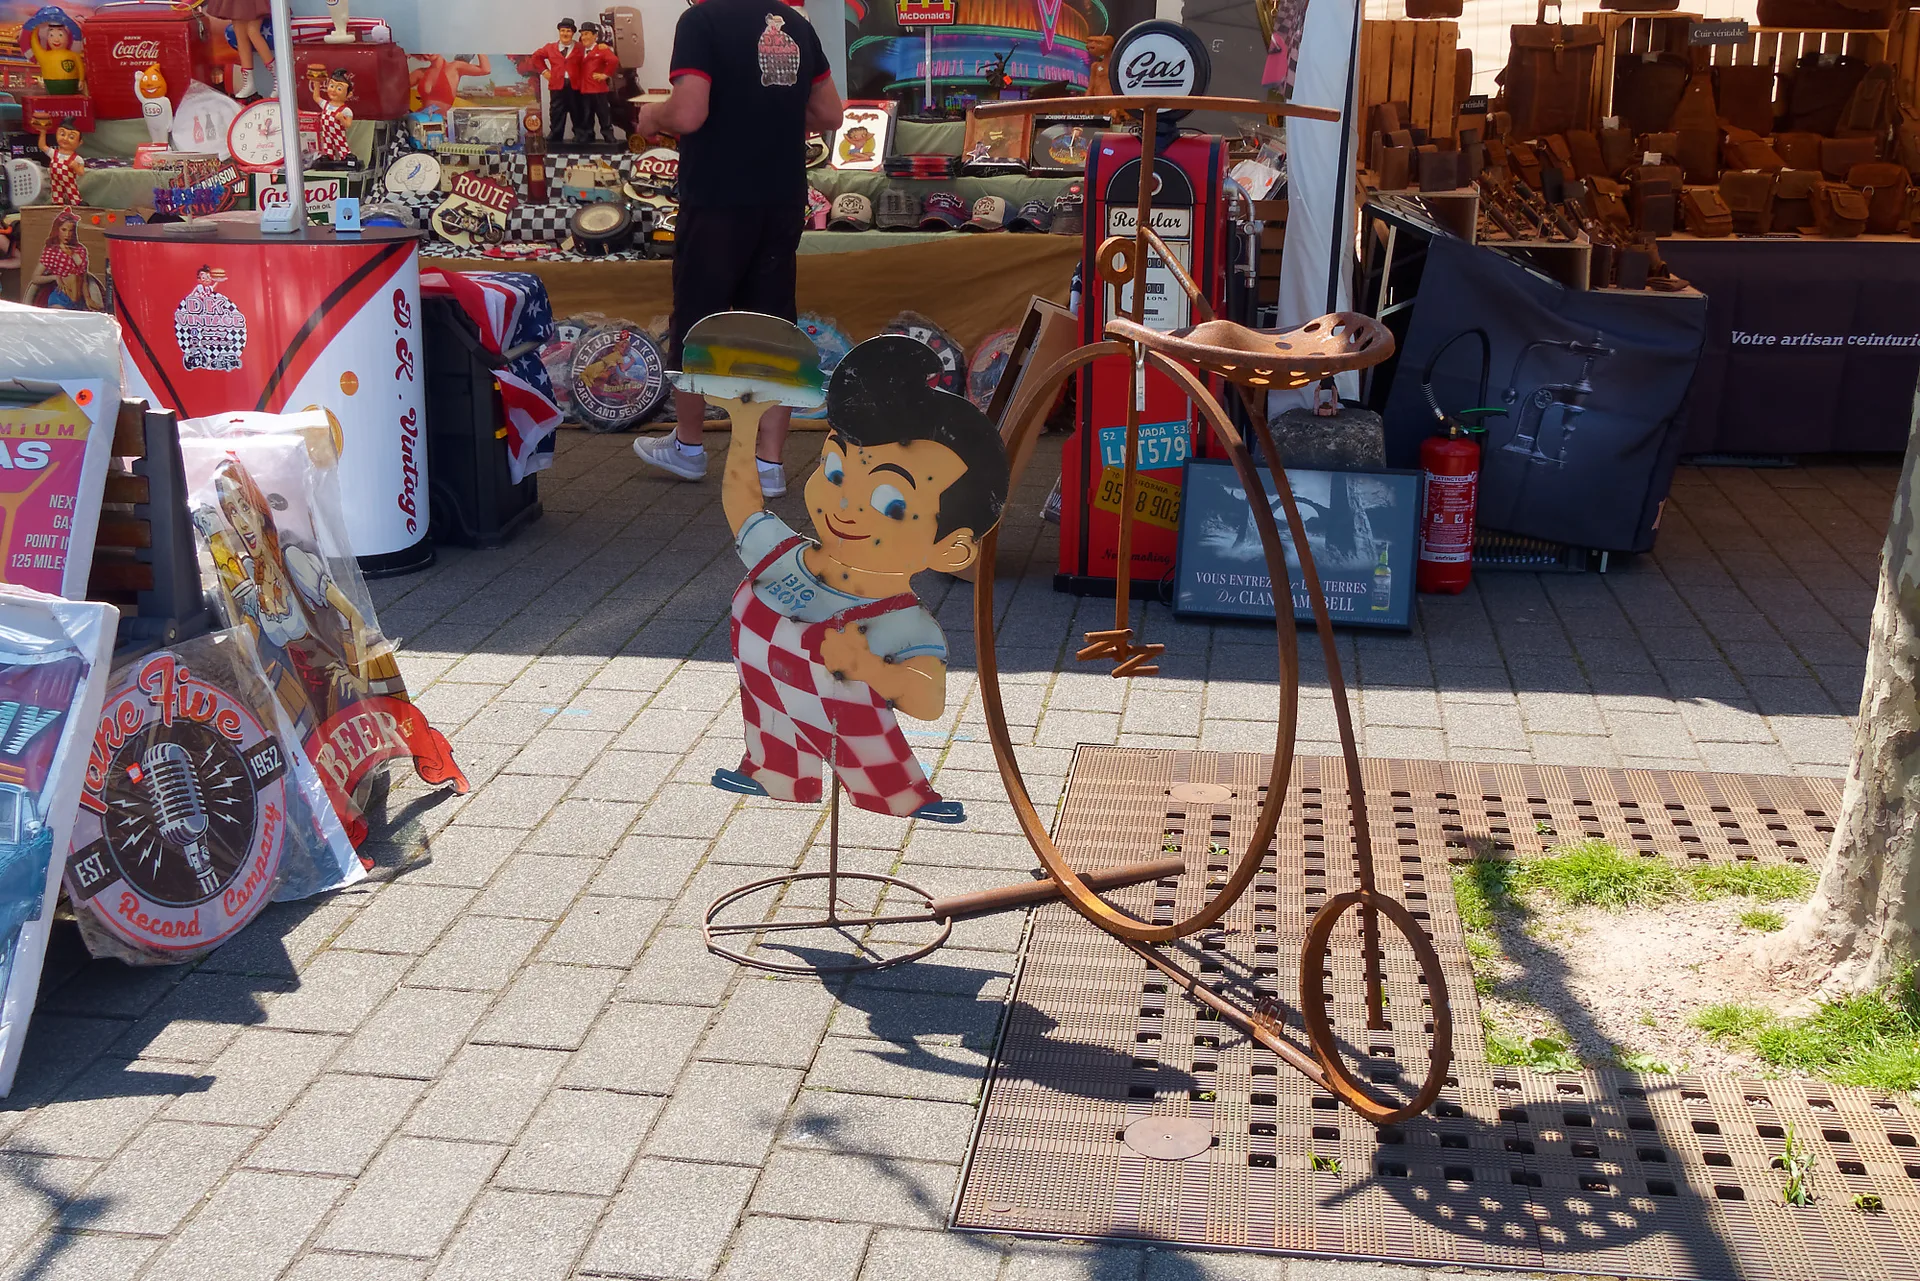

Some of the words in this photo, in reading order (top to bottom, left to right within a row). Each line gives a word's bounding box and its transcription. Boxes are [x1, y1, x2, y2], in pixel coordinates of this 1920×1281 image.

[899, 12, 951, 21] McDonald's
[1694, 30, 1711, 38] Cuir
[112, 40, 160, 59] Coca-Cola
[1125, 51, 1187, 89] Gas
[144, 106, 161, 115] ESSO
[254, 112, 261, 120] 11
[266, 108, 275, 116] 12
[244, 121, 253, 129] 10
[239, 132, 246, 141] 9
[241, 143, 248, 151] 8
[275, 149, 282, 157] 5
[262, 153, 268, 161] 6
[640, 160, 679, 176] ROU
[258, 182, 338, 212] Casrol
[455, 175, 514, 211] ROUTE
[1112, 211, 1182, 228] Reular
[175, 312, 245, 328] VINTAGE
[1731, 330, 1777, 346] Votre
[1780, 332, 1844, 347] artisan
[579, 333, 659, 372] STUDEAKER
[595, 408, 617, 418] AND
[619, 390, 654, 418] SERVICE
[397, 406, 420, 536] Vintage
[49, 494, 77, 510] NEX
[24, 533, 59, 549] POINT
[11, 553, 32, 568] 125
[1130, 551, 1171, 564] moking
[781, 573, 815, 602] BIG
[1196, 571, 1227, 585] VOUS
[1229, 574, 1273, 588] ENTREZ
[1323, 580, 1368, 594] TERRES
[764, 581, 807, 612] BOY
[1215, 588, 1237, 603] Du
[1239, 590, 1276, 606] CLAN
[79, 699, 144, 815] Take
[138, 655, 244, 742] Five
[316, 711, 411, 789] BEER
[250, 745, 283, 780] 1952
[224, 800, 283, 918] Company
[75, 852, 110, 888] EST.
[118, 891, 203, 938] Record
